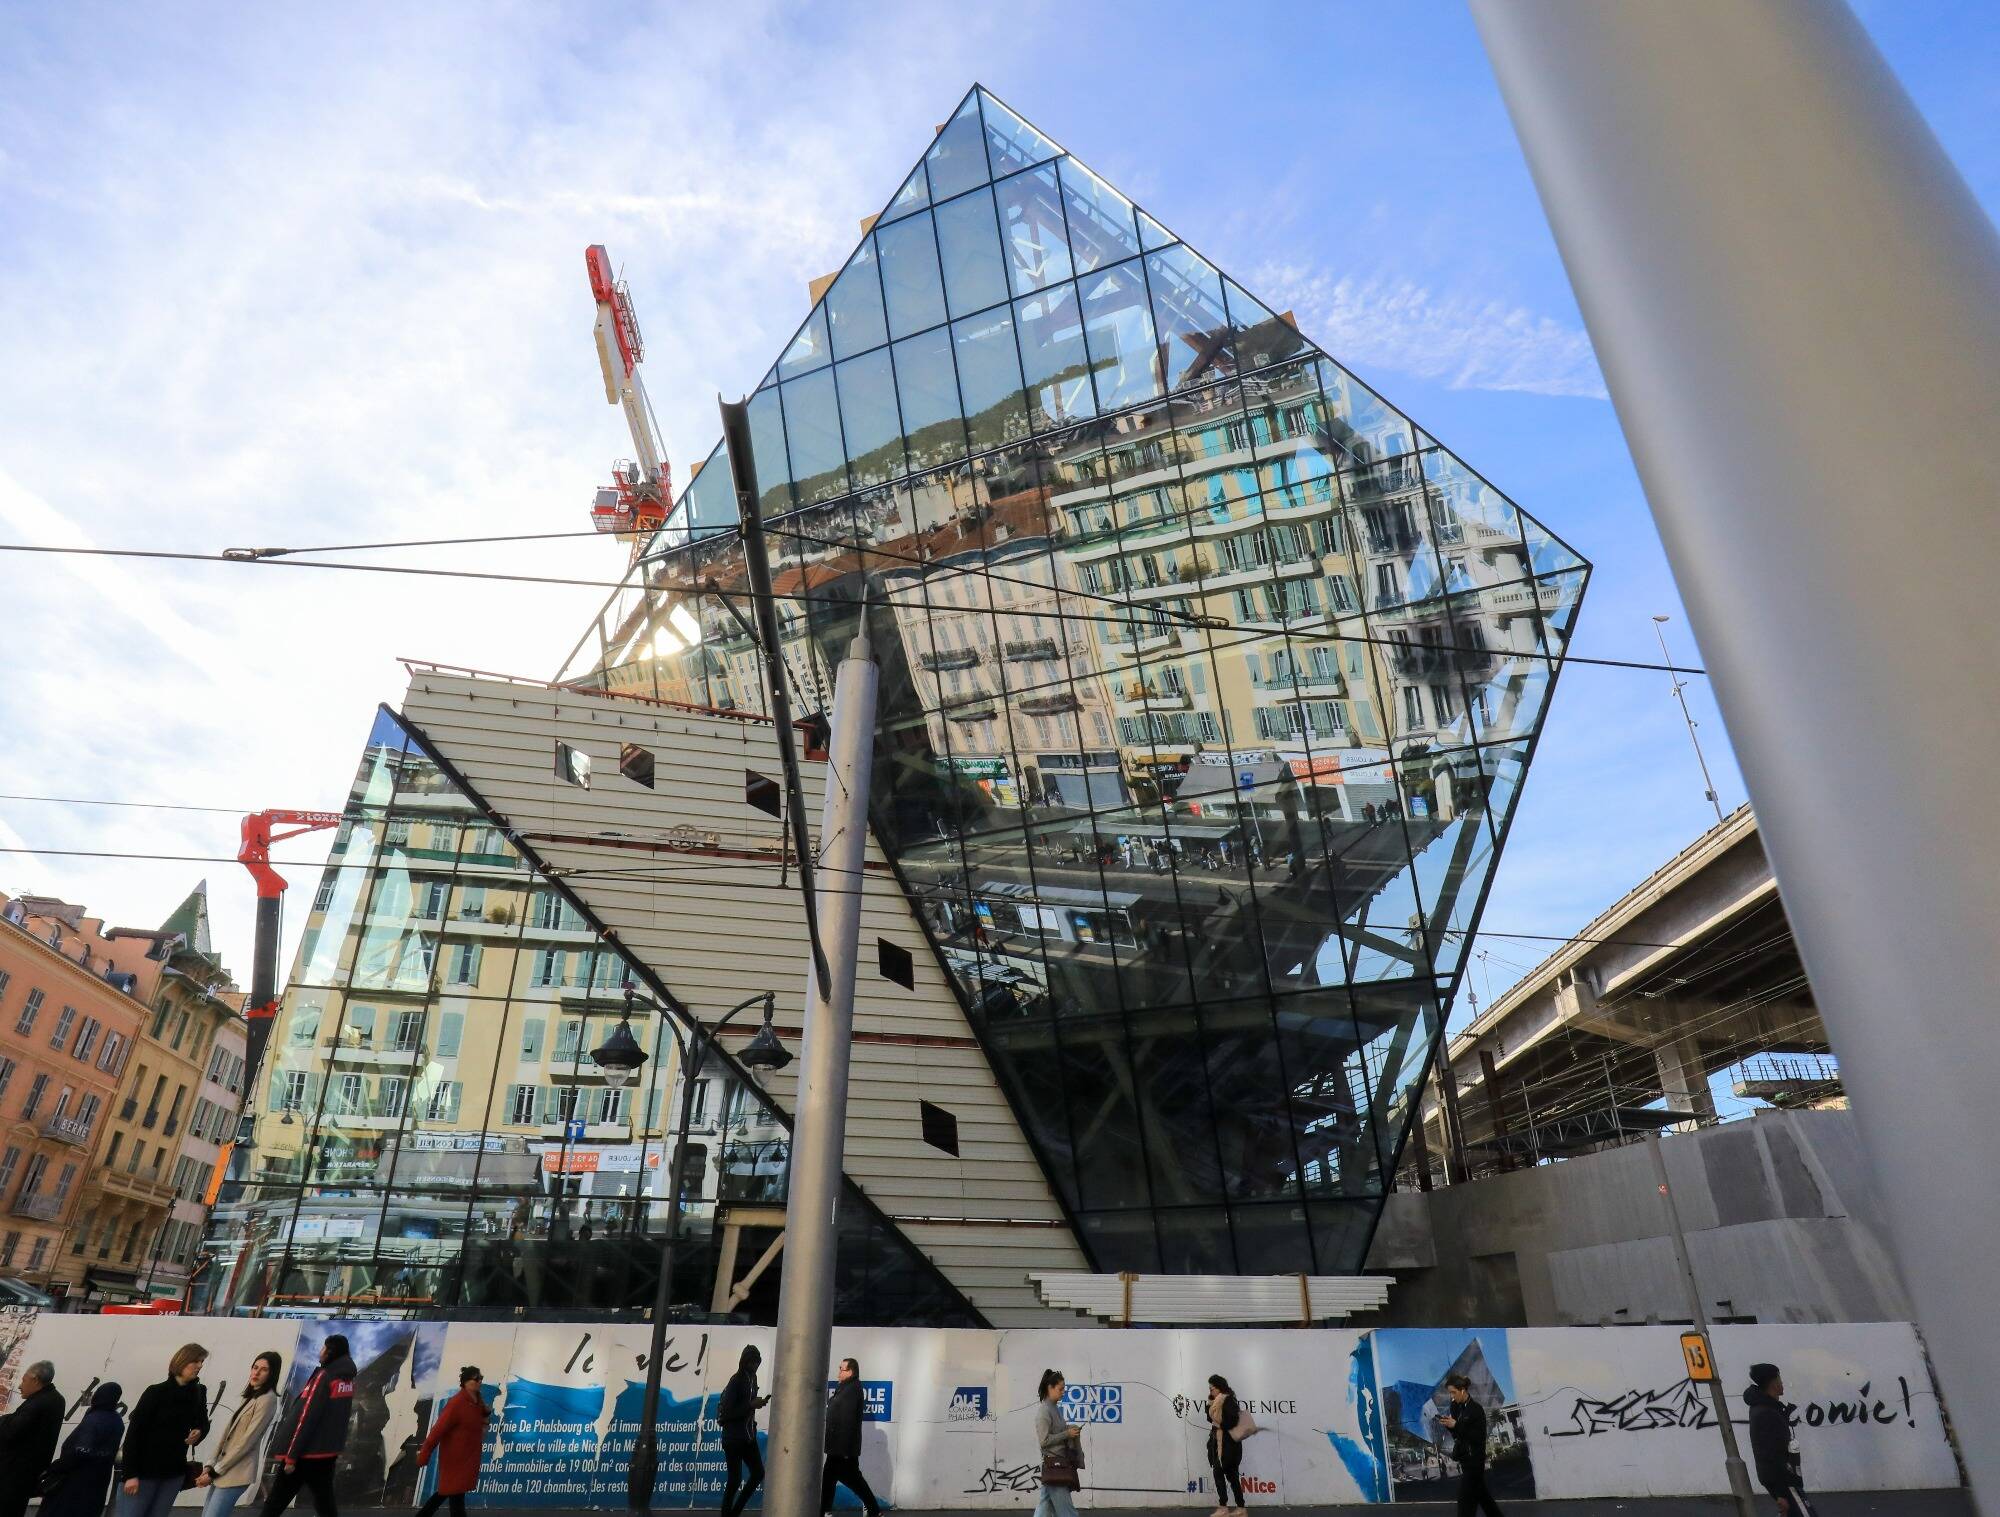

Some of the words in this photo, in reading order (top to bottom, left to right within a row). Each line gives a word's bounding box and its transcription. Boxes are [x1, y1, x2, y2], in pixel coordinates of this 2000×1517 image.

[1058, 1404, 1121, 1423] MMO
[1260, 1400, 1297, 1414] NICE
[519, 1419, 531, 1433] De
[533, 1418, 582, 1436] Phalsbourg
[584, 1420, 594, 1433] et
[515, 1441, 535, 1453] avec
[537, 1439, 546, 1453] la
[548, 1439, 566, 1453] ville
[568, 1439, 579, 1453] de
[581, 1439, 598, 1453] Nice
[602, 1440, 611, 1453] et
[613, 1438, 621, 1453] la
[669, 1441, 689, 1456] pour
[505, 1457, 553, 1473] immobilier
[555, 1458, 566, 1473] de
[569, 1459, 579, 1473] 19
[581, 1459, 599, 1473] 000
[669, 1458, 683, 1473] des
[685, 1460, 728, 1473] commerce
[482, 1478, 509, 1494] Hilton
[511, 1479, 523, 1494] de
[525, 1479, 542, 1494] 120
[543, 1479, 588, 1496] chambres,
[591, 1479, 606, 1493] des
[658, 1480, 667, 1493] et
[669, 1482, 686, 1493] une
[711, 1478, 722, 1493] de
